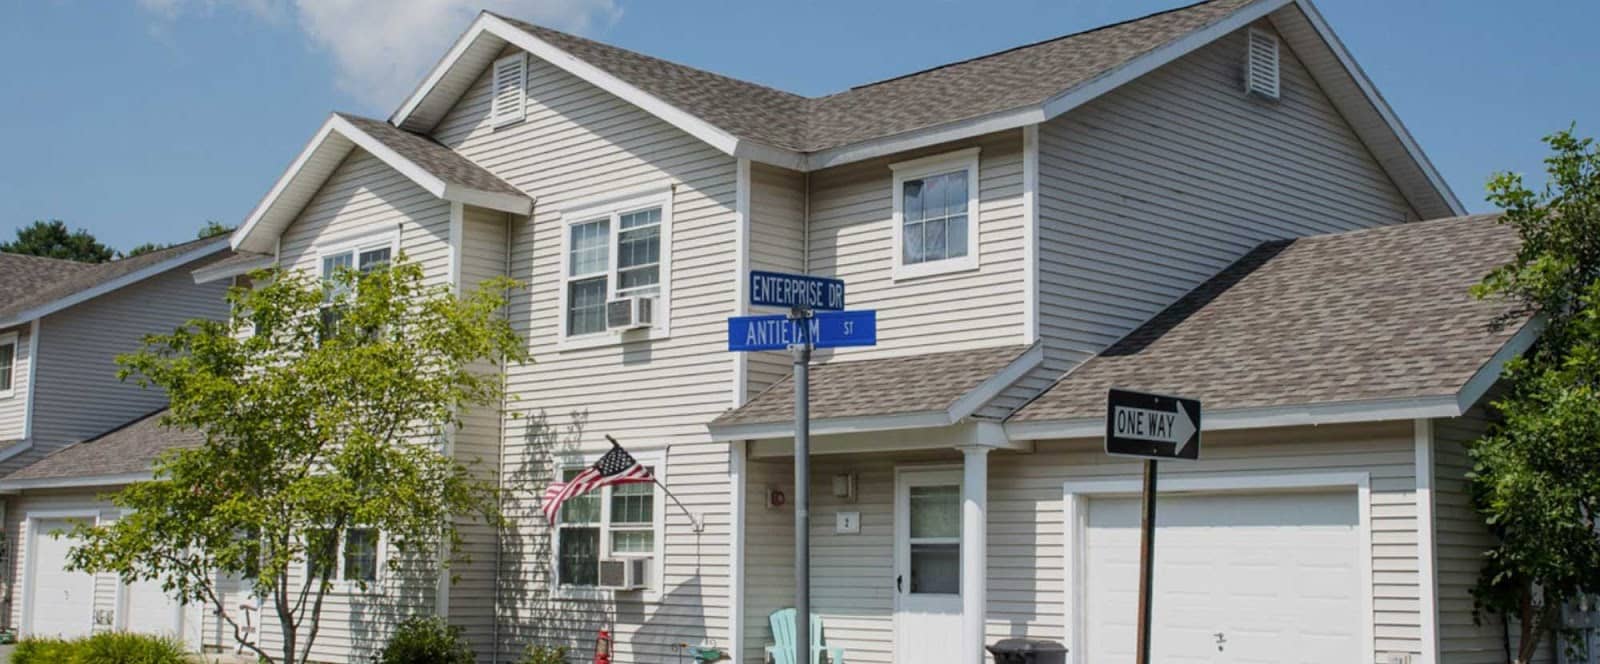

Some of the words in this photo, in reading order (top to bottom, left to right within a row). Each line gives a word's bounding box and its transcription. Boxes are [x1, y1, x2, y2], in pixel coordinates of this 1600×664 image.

[753, 275, 824, 307] ENTERPRISE
[828, 283, 843, 307] DR
[843, 321, 854, 335] ST
[1117, 409, 1144, 435] ONE
[1148, 412, 1175, 439] WAY
